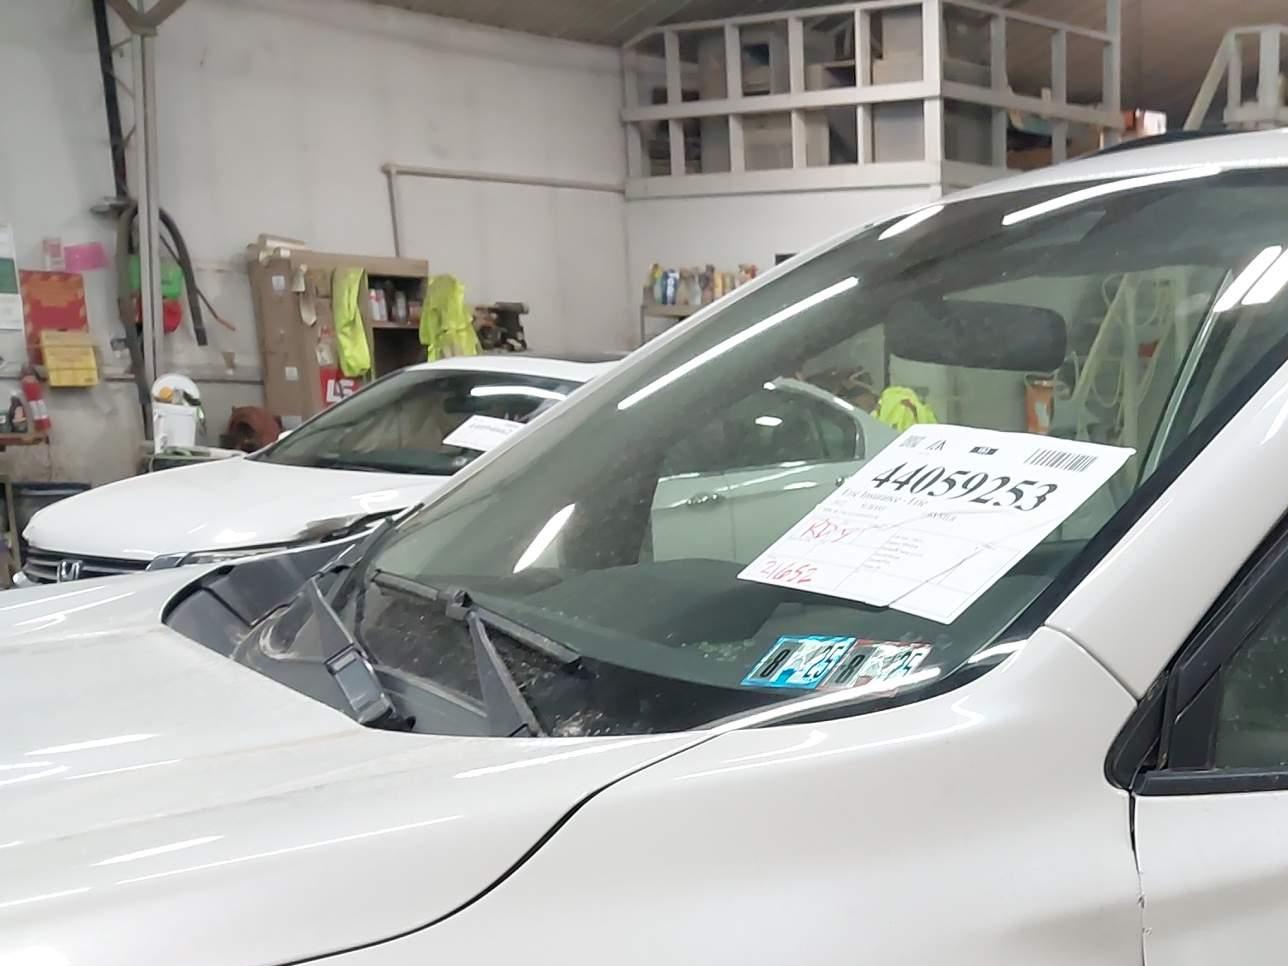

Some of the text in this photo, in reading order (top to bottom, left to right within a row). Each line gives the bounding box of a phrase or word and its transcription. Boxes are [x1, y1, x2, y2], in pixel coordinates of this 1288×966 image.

[871, 462, 1058, 512] 44059253
[759, 650, 791, 678] 8
[834, 654, 866, 684] 8
